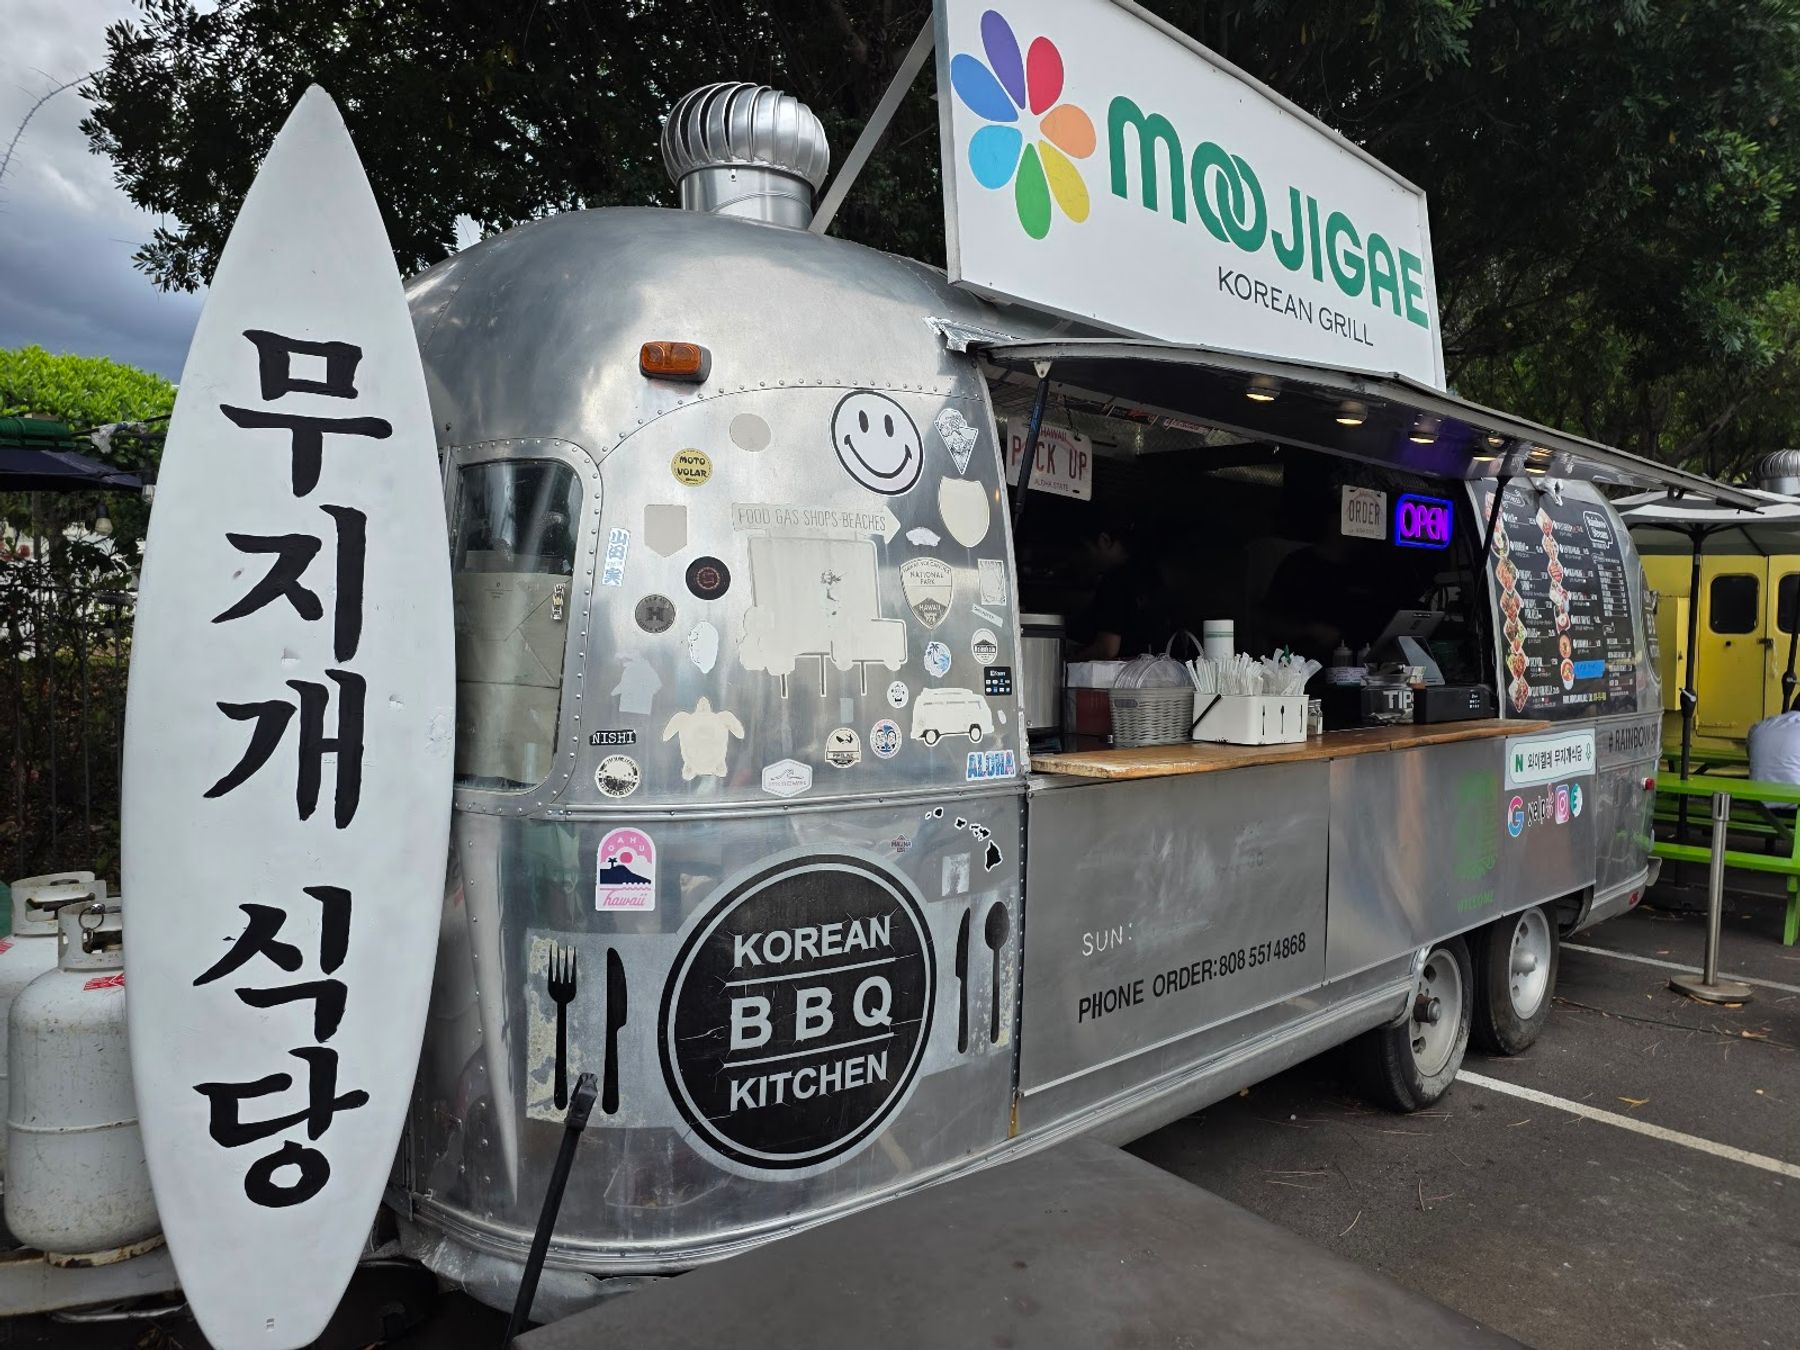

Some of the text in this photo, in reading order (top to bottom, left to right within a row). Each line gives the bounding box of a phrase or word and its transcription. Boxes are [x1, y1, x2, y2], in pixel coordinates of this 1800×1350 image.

[1218, 265, 1374, 347] KOREAN GRILL
[679, 456, 706, 466] MOTO
[1012, 435, 1087, 480] PCK UP
[677, 467, 708, 478] VOLAR
[738, 508, 771, 525] FOOD
[776, 508, 799, 526] GAS
[1349, 500, 1380, 525] ORDER
[1401, 502, 1448, 541] OPEN
[910, 571, 944, 579] NATIONAL
[591, 731, 635, 744] NISHI
[193, 329, 392, 1208] 무지개 식당
[967, 751, 1015, 779] ALOHA
[607, 837, 645, 852] OAHU
[733, 914, 892, 968] KOREAN
[1078, 979, 1145, 1025] PHONE
[1248, 932, 1307, 967] 5514868
[730, 1051, 888, 1112] KITCHEN
